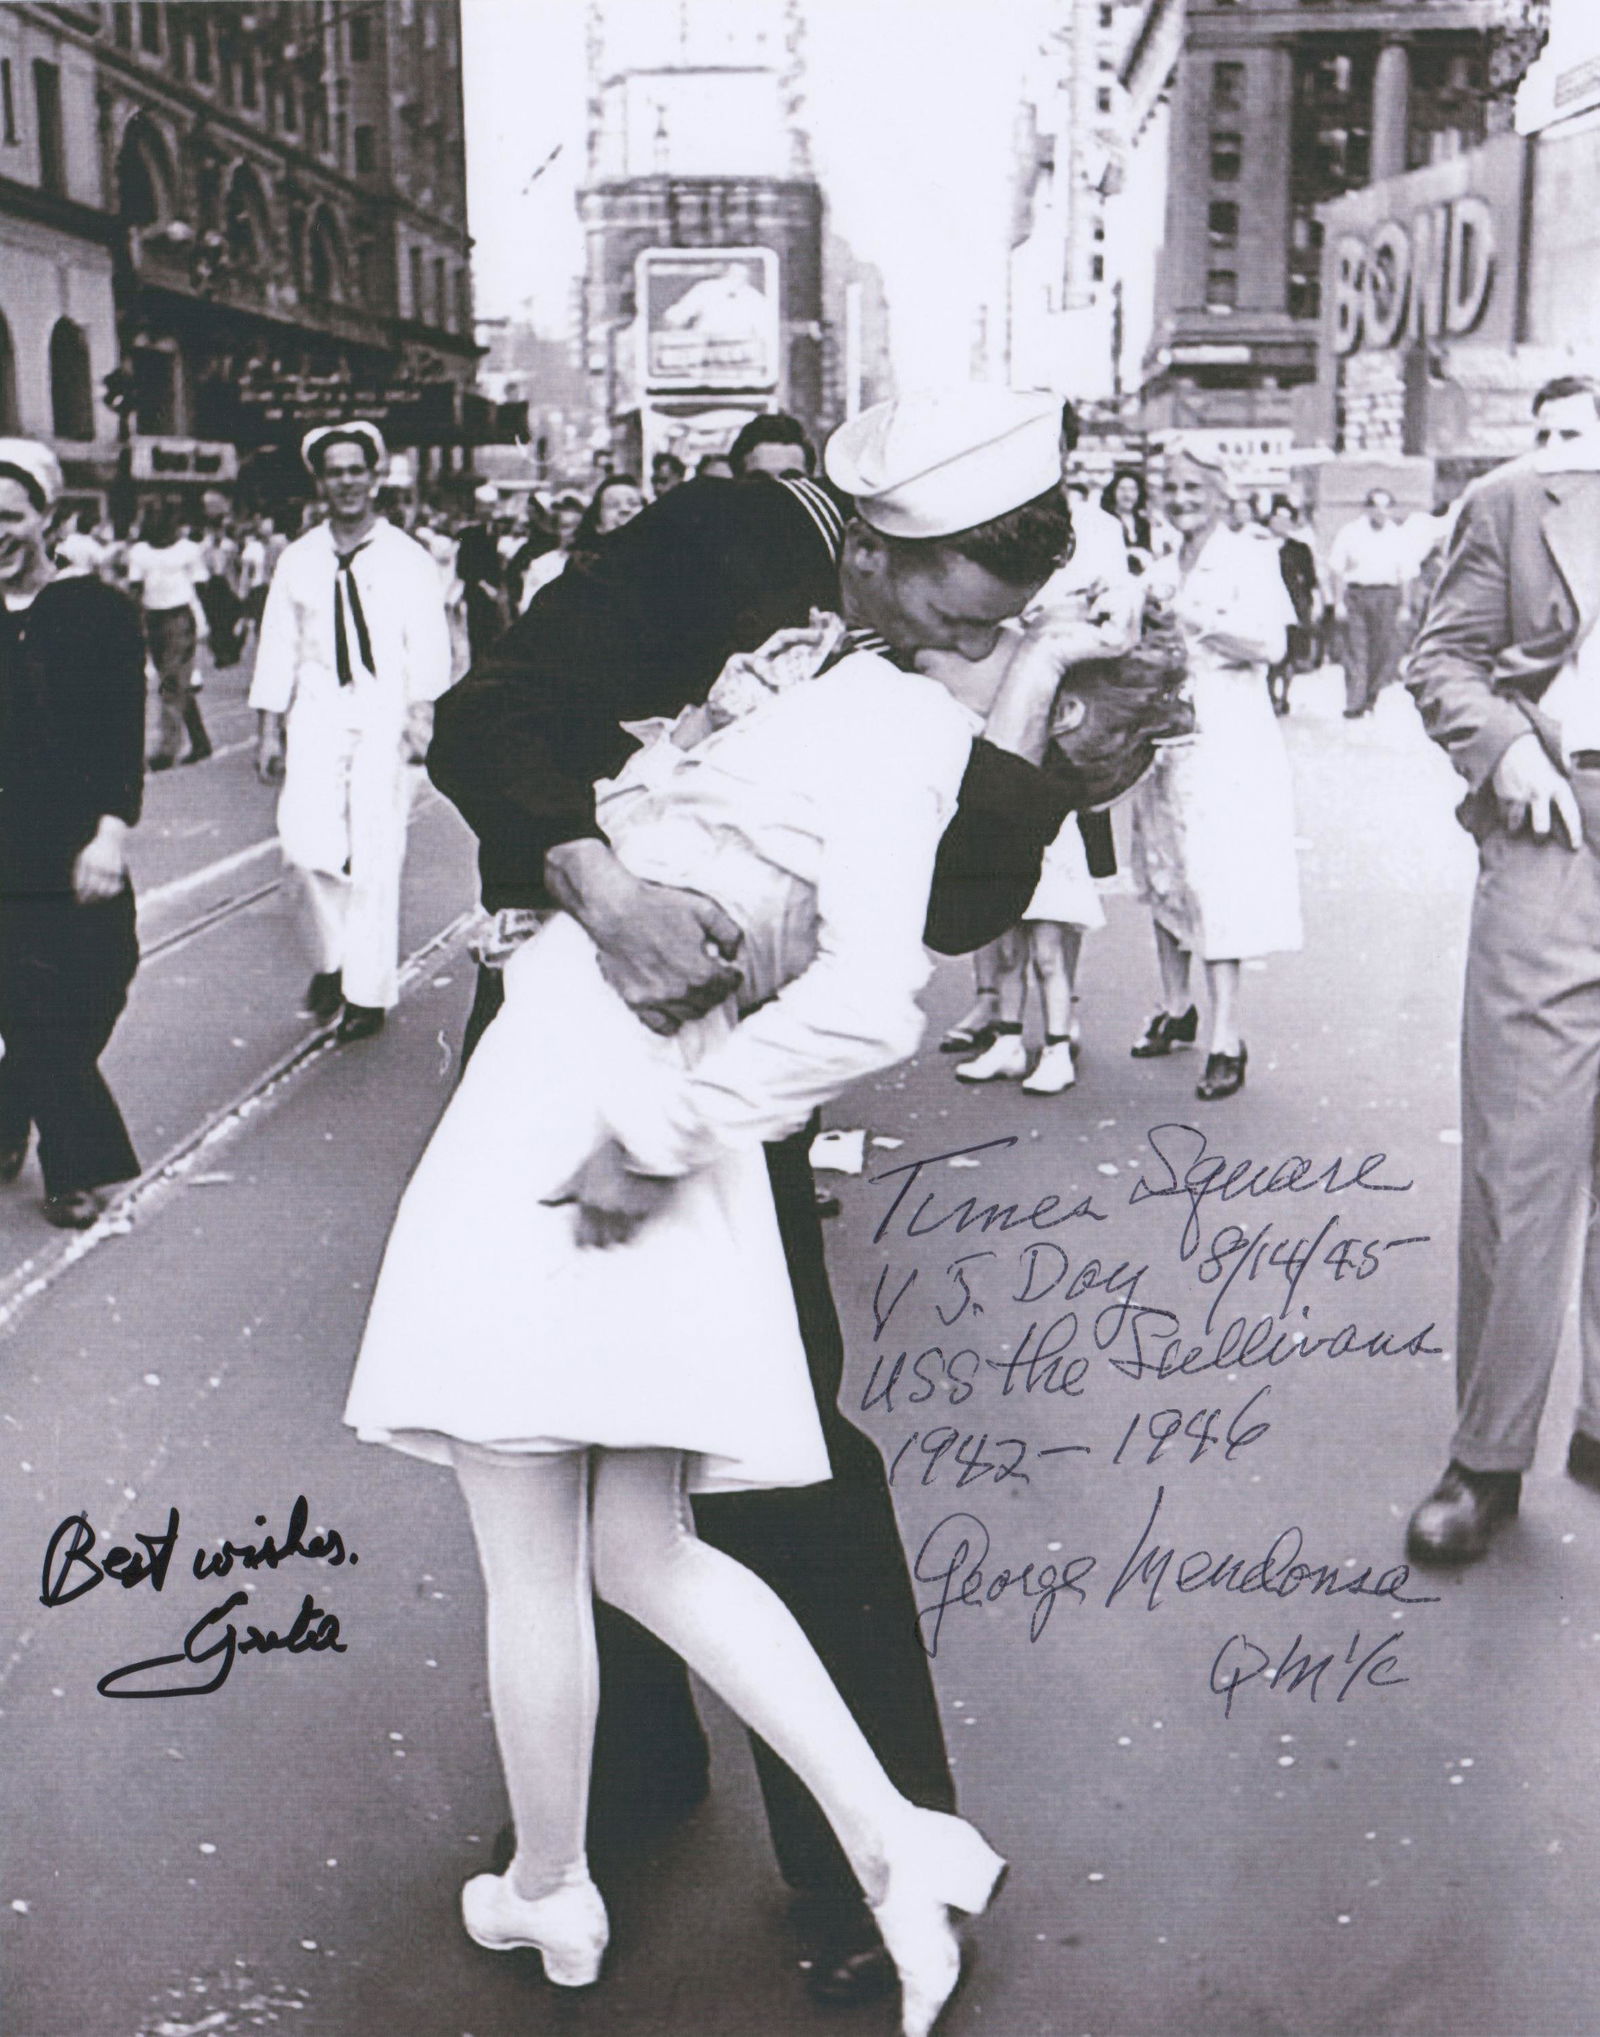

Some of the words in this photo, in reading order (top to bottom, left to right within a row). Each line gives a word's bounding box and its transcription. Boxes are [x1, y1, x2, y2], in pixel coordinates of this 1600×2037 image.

[1331, 198, 1494, 356] BOND
[868, 1136, 1108, 1243] Times
[1129, 1124, 1414, 1262] Square
[1012, 1242, 1160, 1350] Day
[1198, 1215, 1431, 1336] 8/14/45
[861, 1347, 980, 1412] USS
[985, 1312, 1089, 1397] the
[1107, 1305, 1443, 1380] Sullivans
[39, 1506, 180, 1607] Best
[915, 1512, 1098, 1658] George
[1105, 1486, 1441, 1611] Mendonsa
[97, 1591, 348, 1699] Greta
